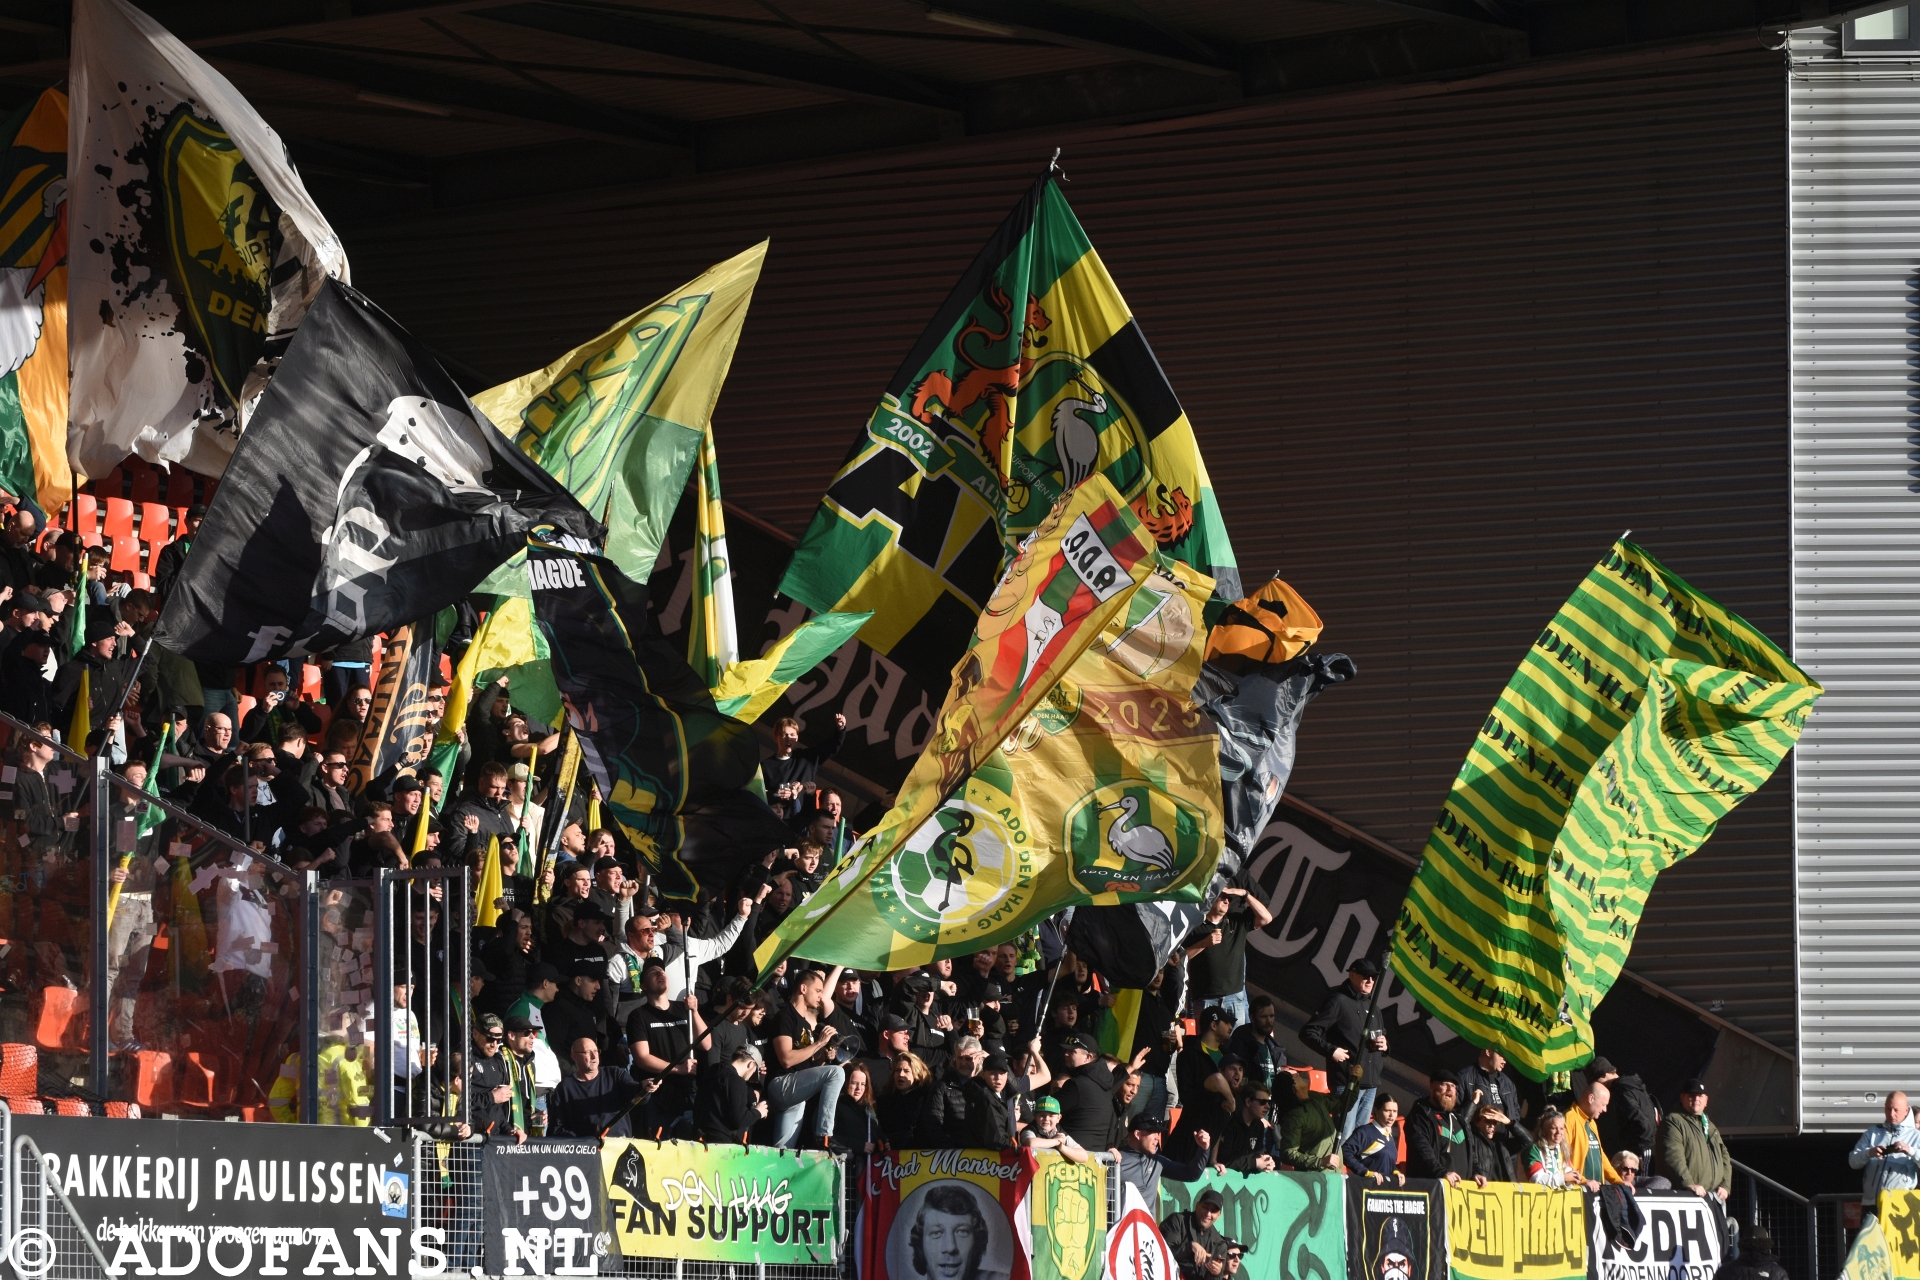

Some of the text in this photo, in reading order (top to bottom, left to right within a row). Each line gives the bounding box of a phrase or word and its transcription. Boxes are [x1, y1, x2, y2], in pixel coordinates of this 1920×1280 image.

[207, 289, 269, 335] DEN
[885, 417, 936, 459] 2002
[1033, 479, 1050, 496] DEN
[1598, 546, 1661, 588] DEN
[1534, 627, 1600, 685] DEN
[1596, 671, 1637, 717] HA
[1040, 696, 1072, 708] UPPORT
[1480, 712, 1545, 773] DEN
[1436, 806, 1500, 872] DEN
[977, 806, 1032, 930] ADO DEN HAAG
[1113, 872, 1140, 881] DEN
[1144, 869, 1181, 881] HAAG
[1400, 905, 1451, 970] DEN
[532, 1144, 540, 1154] IN
[540, 1144, 552, 1154] UN
[552, 1144, 575, 1154] UNICO
[575, 1145, 597, 1155] CIELO
[42, 1152, 386, 1212] BAKKERIJ PAULISSEN
[513, 1165, 592, 1221] +39
[1367, 1197, 1426, 1215] FANATICS THE HAGUE
[607, 1197, 831, 1246] FAN SUPPORT
[1451, 1187, 1584, 1273] DEN HAAG
